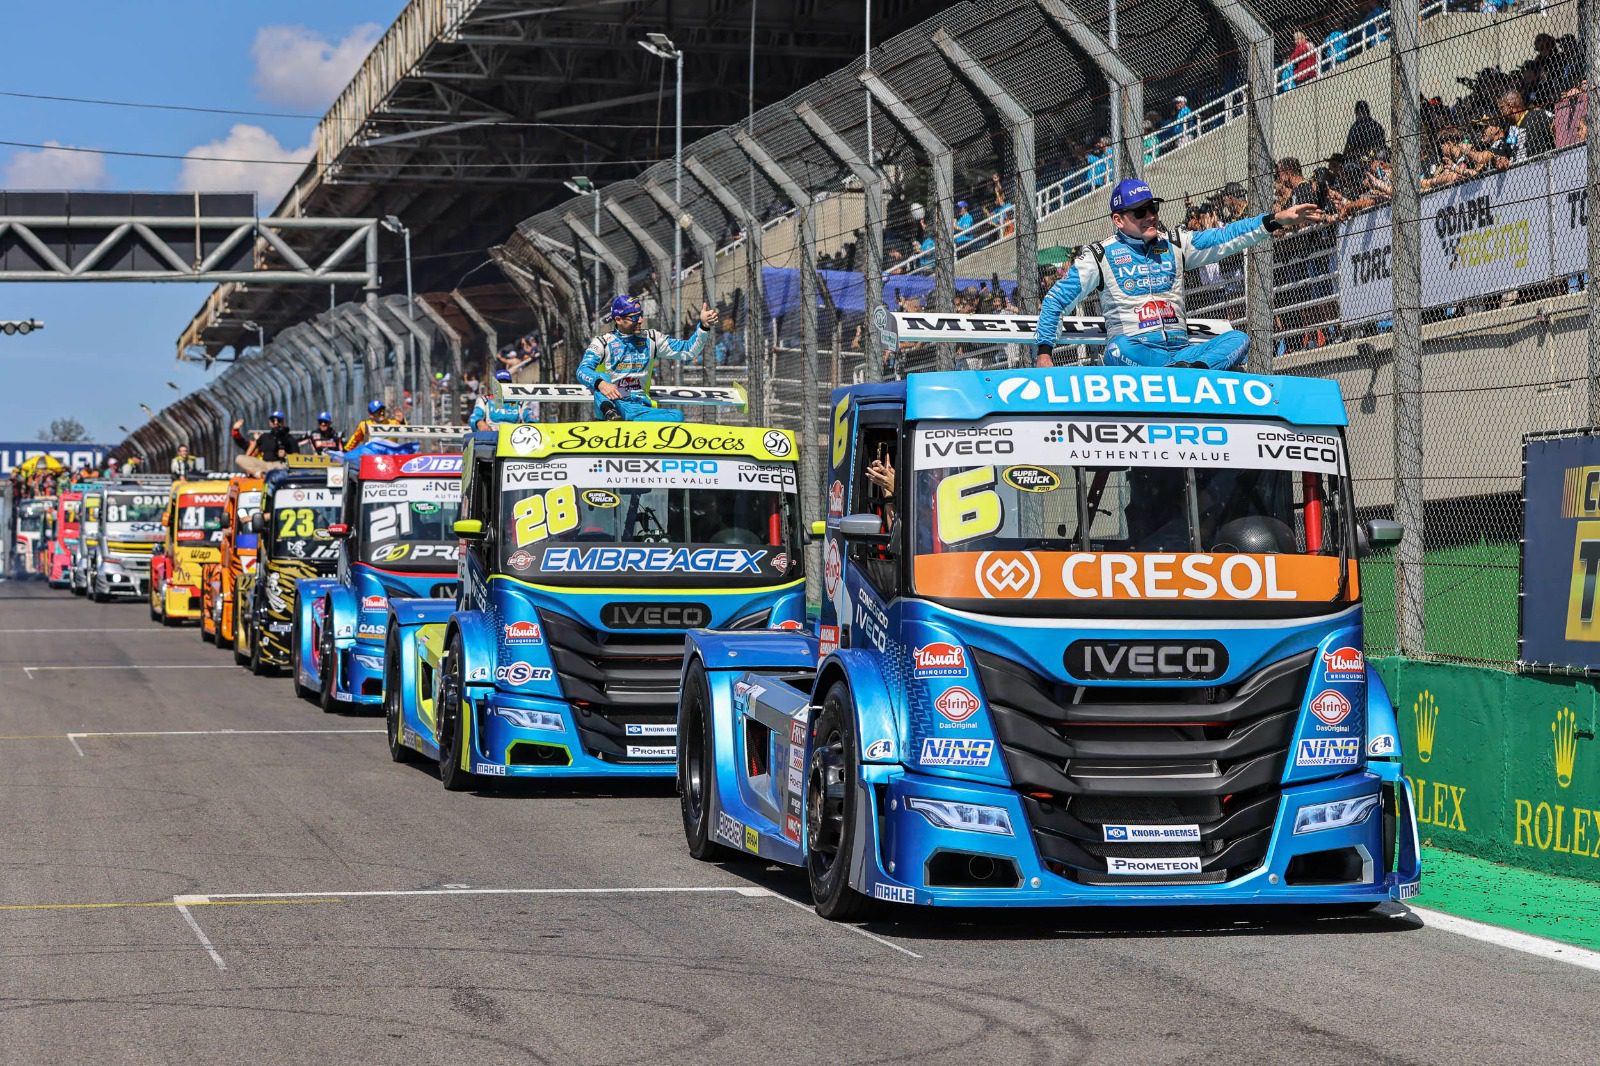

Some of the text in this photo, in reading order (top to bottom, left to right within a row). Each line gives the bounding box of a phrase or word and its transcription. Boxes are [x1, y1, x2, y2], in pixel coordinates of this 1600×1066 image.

[1113, 195, 1122, 207] 61
[1434, 194, 1494, 239] ODAPEL
[1118, 261, 1172, 278] IVECO
[1045, 375, 1273, 406] LIBRELATO
[558, 425, 647, 450] Sodiê
[832, 392, 850, 470] 6
[1068, 424, 1229, 445] NEXPRO
[924, 440, 1015, 458] IVECO
[1070, 449, 1231, 462] AUTHENTIC VALUE
[1257, 444, 1338, 464] IVECO
[606, 460, 719, 474] NEXPRO
[506, 471, 568, 484] IVECO
[606, 476, 719, 486] AUTHENTIC VALUE
[738, 472, 795, 486] IVECO
[1016, 475, 1051, 485] TRUCK
[364, 489, 408, 498] IVECO
[937, 464, 1003, 542] 6
[107, 504, 128, 522] 81
[181, 506, 206, 530] 41
[513, 484, 580, 549] 28
[279, 508, 315, 538] 23
[369, 501, 414, 544] 21
[540, 547, 769, 573] EMBREAGEX
[1061, 552, 1298, 600] CRESOL
[613, 606, 703, 625] IVECO
[506, 624, 539, 637] Usual
[855, 603, 887, 654] IVECO
[915, 647, 962, 666] Usual
[1084, 645, 1216, 673] IVECO
[1324, 653, 1363, 670] Usual
[496, 666, 552, 680] CISER
[918, 668, 962, 676] BRINQUEDOS
[939, 698, 976, 710] elring
[1313, 701, 1348, 713] elring
[939, 721, 978, 730] DasOriginal
[1315, 723, 1350, 732] DasOriginal
[476, 763, 506, 775] MAHLE
[1131, 828, 1199, 838] KNORR-BREMSE
[1110, 859, 1200, 871] PROMETEON
[875, 884, 915, 903] MAHLE
